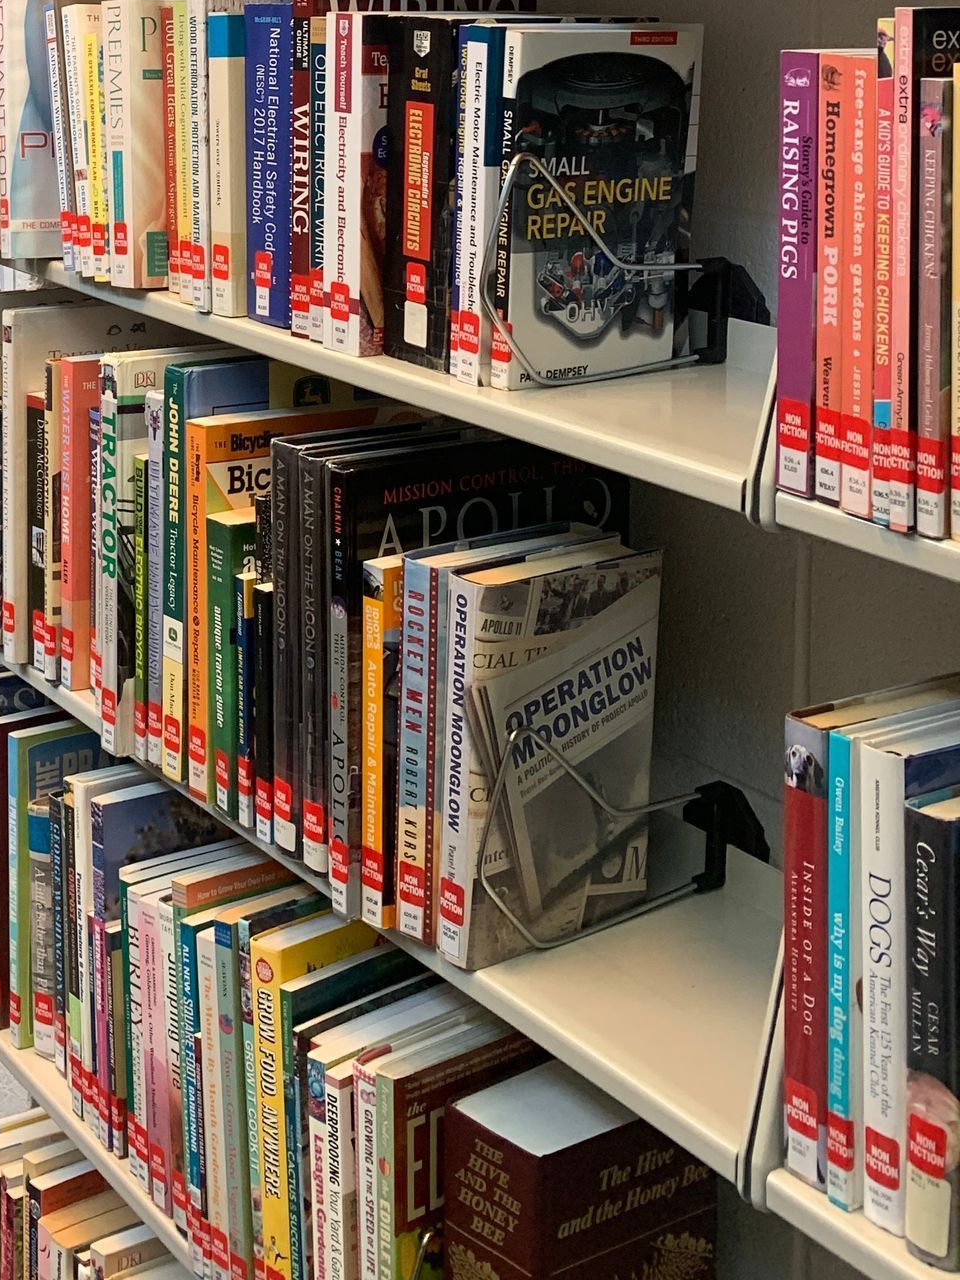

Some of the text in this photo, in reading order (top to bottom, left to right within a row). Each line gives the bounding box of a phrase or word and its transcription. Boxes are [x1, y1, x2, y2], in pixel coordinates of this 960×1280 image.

[107, 6, 124, 129] PREEMIES
[507, 45, 515, 85] DEMPSEY
[264, 28, 281, 218] National Electrical Safety
[470, 61, 483, 215] Electric Motor Maintenance
[501, 109, 514, 156] SMALL
[252, 108, 266, 224] 2017 Handbook
[293, 103, 310, 235] WIRING
[336, 115, 348, 214] Electricity and
[405, 108, 423, 252] ELECTRONIC CIRCUITS
[526, 176, 672, 209] GAS ENGINE
[528, 155, 591, 178] SMALL
[781, 98, 800, 280] RAISING PIGS
[527, 210, 607, 241] REPAIR
[800, 189, 810, 228] Guide
[822, 100, 841, 328] Homegrown PORK
[850, 69, 867, 342] free-range chicken gardens
[496, 250, 507, 298] REPAIR
[876, 153, 890, 366] GUIDE KEEPING CHICKENS
[545, 364, 589, 381] DEMPSEY
[780, 423, 808, 441] FICTION
[785, 413, 801, 427] NON
[101, 412, 118, 580] TRACTOR
[166, 397, 180, 611] JOHN DEERE Tractor Legacy
[383, 478, 453, 506] MISSION
[192, 494, 200, 614] Bicycle Maintenance
[214, 605, 222, 650] antique
[481, 619, 512, 635] APOLLO
[367, 662, 378, 753] Auto Repair
[446, 593, 469, 834] OPERATION MOONGLOW
[506, 636, 645, 735] OPERATION
[510, 656, 654, 770] MOONGLOW
[402, 589, 425, 863] ROCKET MEN ROBERT KURS
[561, 727, 591, 753] HISTORY
[834, 777, 845, 812] Gwen
[399, 882, 424, 898] FICTION
[403, 874, 418, 887] NON
[911, 841, 936, 978] Cesar's Way
[802, 861, 815, 1037] INSIDE OF DOG
[868, 872, 892, 968] DOGS
[927, 1001, 940, 1057] CESAR
[261, 1102, 281, 1200] ANYWHERE
[311, 1133, 326, 1202] Lasagna
[326, 1092, 340, 1188] DEERPROOFING
[363, 1108, 374, 1170] GROWING
[474, 1138, 504, 1165] THE
[599, 1147, 674, 1192] The Hive
[865, 1153, 899, 1179] FICTION
[870, 1144, 890, 1164] NON
[454, 1168, 522, 1217] AND THE
[467, 1153, 510, 1189] HIVE
[456, 1190, 519, 1233] HONEY
[470, 1217, 505, 1247] BEE
[557, 1175, 680, 1240] and the Honey
